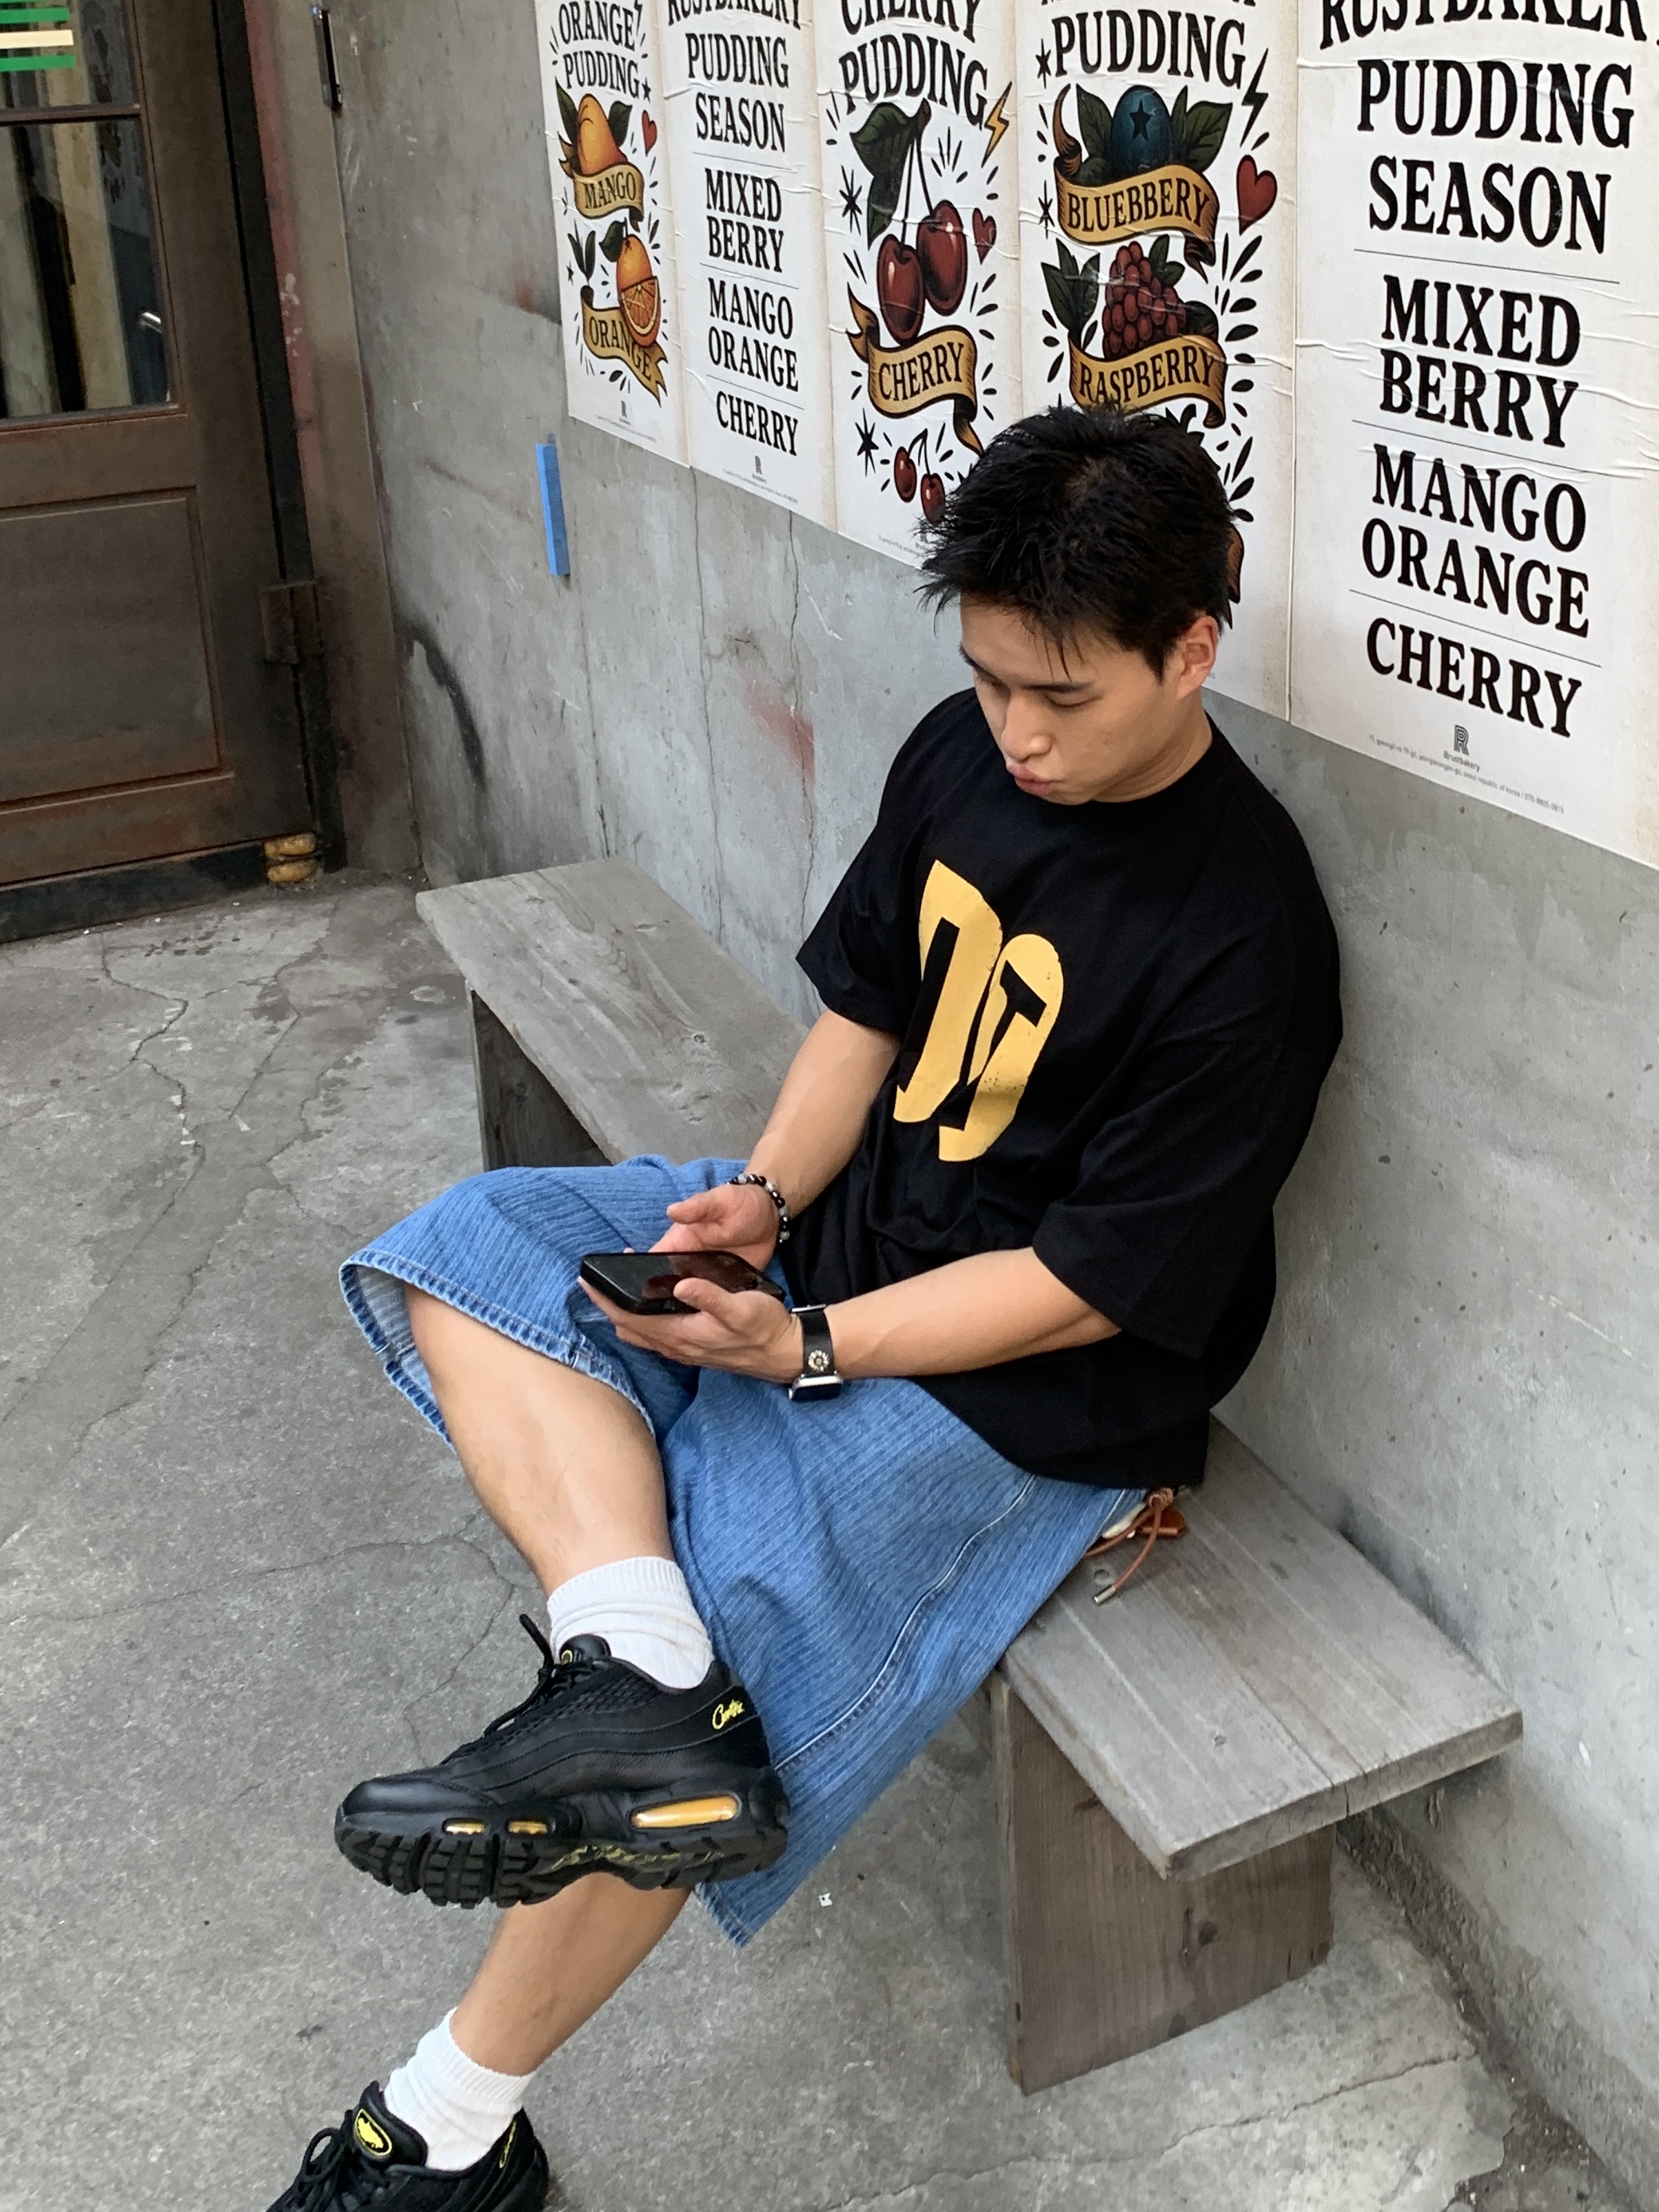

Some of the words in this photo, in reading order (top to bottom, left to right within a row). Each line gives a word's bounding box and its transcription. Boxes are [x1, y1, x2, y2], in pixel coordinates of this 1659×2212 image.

[559, 0, 635, 52] ORANGE
[1051, 9, 1245, 89] PUDDING
[562, 50, 640, 99] PUDDING
[685, 33, 789, 89] PUDDING
[839, 32, 988, 131] PUDDING
[695, 92, 785, 152] SEASON
[1357, 59, 1634, 148] PUDDING
[583, 172, 636, 209] MANGO
[704, 167, 782, 222] MIXED
[1067, 177, 1210, 233] BLUEBBERY
[1370, 155, 1611, 254] SEASON
[706, 215, 784, 273] BERRY
[708, 277, 794, 339] MANGO
[1381, 274, 1580, 367] MIXED
[589, 316, 652, 381] ORANGE
[709, 326, 799, 392] ORANGE
[878, 342, 964, 401] CHERRY
[1079, 345, 1216, 407] RASPBERRY
[716, 390, 799, 456] CHERRY
[1379, 348, 1578, 448] BERRY
[1372, 443, 1586, 551] MANGO
[1362, 518, 1589, 638] ORANGE
[1367, 618, 1582, 738] CHERRY
[1453, 724, 1469, 755] R
